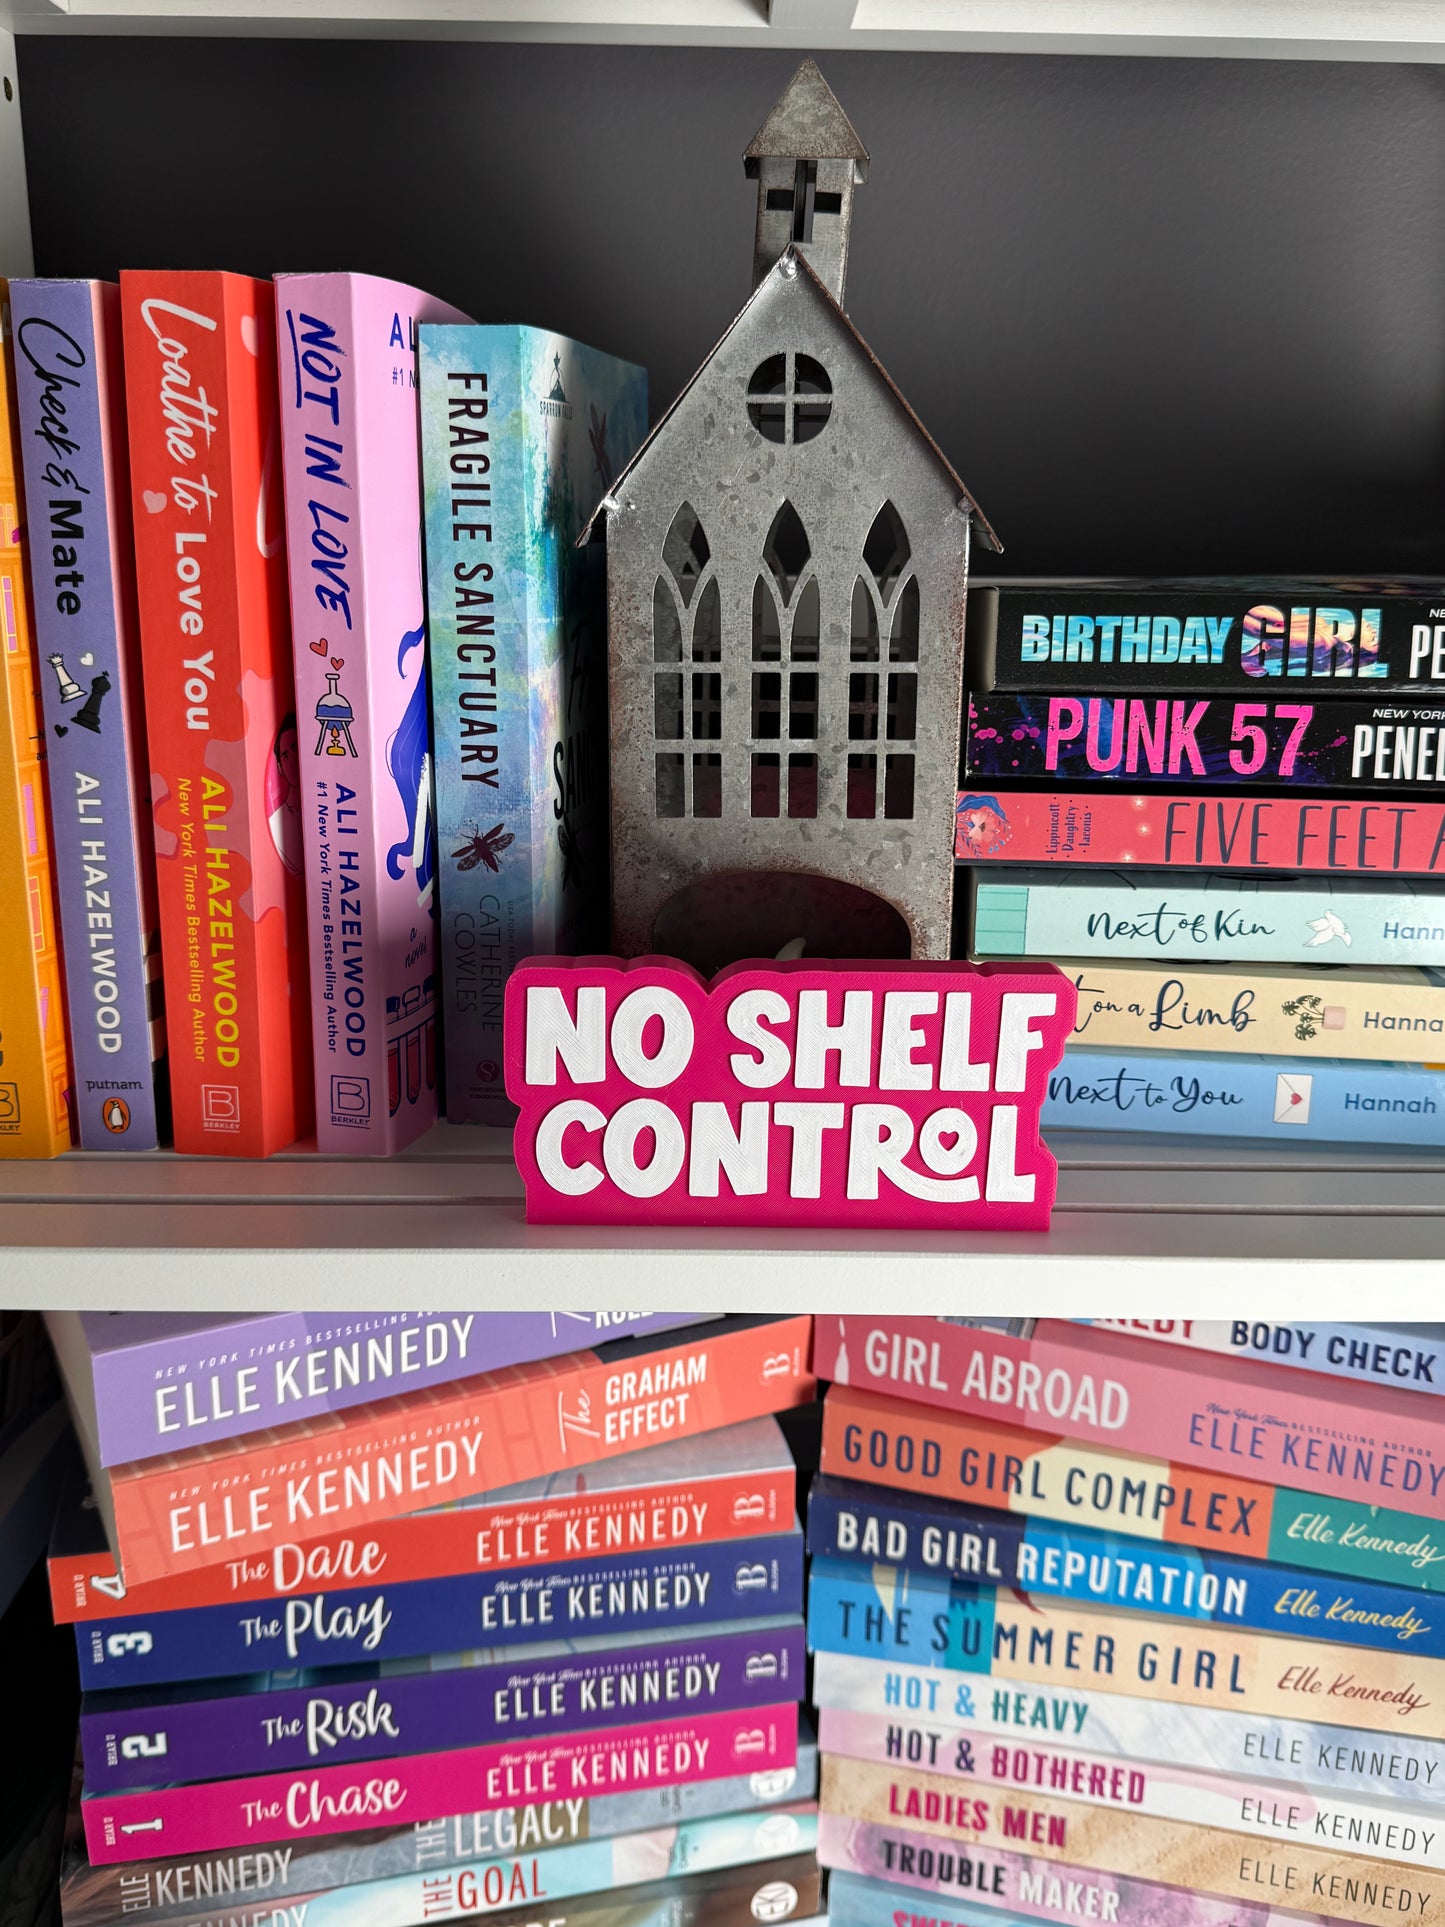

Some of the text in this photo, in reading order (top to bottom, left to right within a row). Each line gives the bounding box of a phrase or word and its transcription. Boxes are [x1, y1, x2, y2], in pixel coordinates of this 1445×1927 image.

[18, 317, 91, 616] Check & Mate
[299, 312, 353, 630] NOT IN LOVE
[140, 298, 218, 731] Loathe to Love You
[447, 372, 500, 790] FRAGILE SANCTUARY
[1020, 605, 1391, 678] BIRTHDAY GIRL
[1044, 697, 1314, 776] PUNK 57
[1372, 709, 1409, 719] NEW
[1045, 803, 1060, 853] Lippincott
[1062, 806, 1080, 851] Daughtry
[1164, 801, 1273, 866] FIVE
[1298, 805, 1417, 870] FEET
[74, 771, 122, 1054] ALI HAZELWOOD
[178, 778, 206, 1062] New York Times Bestselling Author
[201, 776, 240, 1068] ALI HAZELWOOD
[317, 781, 337, 1053] #1 New York Times Bestselling Author
[335, 782, 366, 1057] ALI HAZELWOOD
[410, 927, 418, 941] a
[1178, 914, 1209, 943] of
[1214, 908, 1275, 938] Kin
[453, 912, 477, 1013] COWLES
[479, 895, 503, 1032] CATHERINE
[1093, 979, 1257, 1032] on a Limb
[525, 985, 695, 1089] NO
[726, 989, 1057, 1093] SHELF
[86, 1078, 143, 1091] putnam
[1135, 1082, 1168, 1107] to
[1170, 1076, 1243, 1112] You
[1344, 1092, 1436, 1115] Hannah
[203, 1121, 240, 1130] BERKLEY
[331, 1115, 369, 1126] BERKLEY
[535, 1098, 1036, 1203] CONTROL
[155, 1364, 186, 1380] NEW
[200, 1353, 239, 1368] YORK
[250, 1339, 297, 1357] TIMES
[305, 1312, 408, 1346] BESTSELLING
[155, 1314, 474, 1435] ELLE KENNEDY
[1231, 1320, 1316, 1358] BODY
[1327, 1336, 1437, 1382] CHECK
[605, 1354, 707, 1406] GRAHAM
[865, 1329, 948, 1391] GIRL
[962, 1351, 1128, 1429] ABROAD
[558, 1388, 601, 1454] The
[605, 1393, 689, 1445] EFFECT
[1206, 1402, 1432, 1458] New York Times BESTSELLING AUTHOR
[169, 1416, 480, 1501] NEW YORK TIMES BESTSELLING AUTHOR
[843, 1424, 1257, 1537] GOOD GIRL COMPLEX
[1189, 1413, 1445, 1497] ELLE KENNEDY
[169, 1432, 483, 1553] ELLE KENNEDY
[477, 1503, 708, 1564] ELLE KENNEDY
[836, 1512, 1247, 1616] BAD GIRL REPUTATION
[1286, 1512, 1445, 1568] Elle Kennedy
[76, 1585, 87, 1607] BRIAR
[90, 1573, 126, 1599] 4
[225, 1540, 387, 1592] The Dare
[240, 1595, 392, 1658] The Play
[481, 1571, 711, 1631] ELLE KENNEDY
[1274, 1588, 1432, 1639] Elle Kennedy
[93, 1643, 104, 1664] BRIAR
[107, 1630, 153, 1657] 3
[838, 1600, 1246, 1694] THE SUMMER GIRL
[494, 1662, 721, 1723] ELLE KENNEDY
[885, 1672, 1089, 1735] HOT & HEAVY
[1277, 1666, 1432, 1715] Elle Kennedy
[121, 1731, 168, 1759] 2
[261, 1688, 400, 1756] The Risk
[107, 1744, 118, 1766] BRIAR
[486, 1738, 709, 1799] ELLE KENNEDY
[886, 1724, 1146, 1805] HOT & BOTHERED
[1244, 1733, 1439, 1785] ELLE KENNEDY
[120, 1817, 163, 1835] 1
[240, 1778, 407, 1829] The Chase
[414, 1797, 584, 1870] THE LEGACY
[889, 1783, 1067, 1849] LADIES MEN
[1241, 1797, 1436, 1856] ELLE KENNEDY
[105, 1826, 116, 1846] BRIAR
[120, 1847, 293, 1913] ELLE KENNEDY
[423, 1858, 547, 1918] THE GOAL
[881, 1839, 1121, 1924] TROUBLE MAKER
[1239, 1857, 1432, 1917] ELLE KENNEDY
